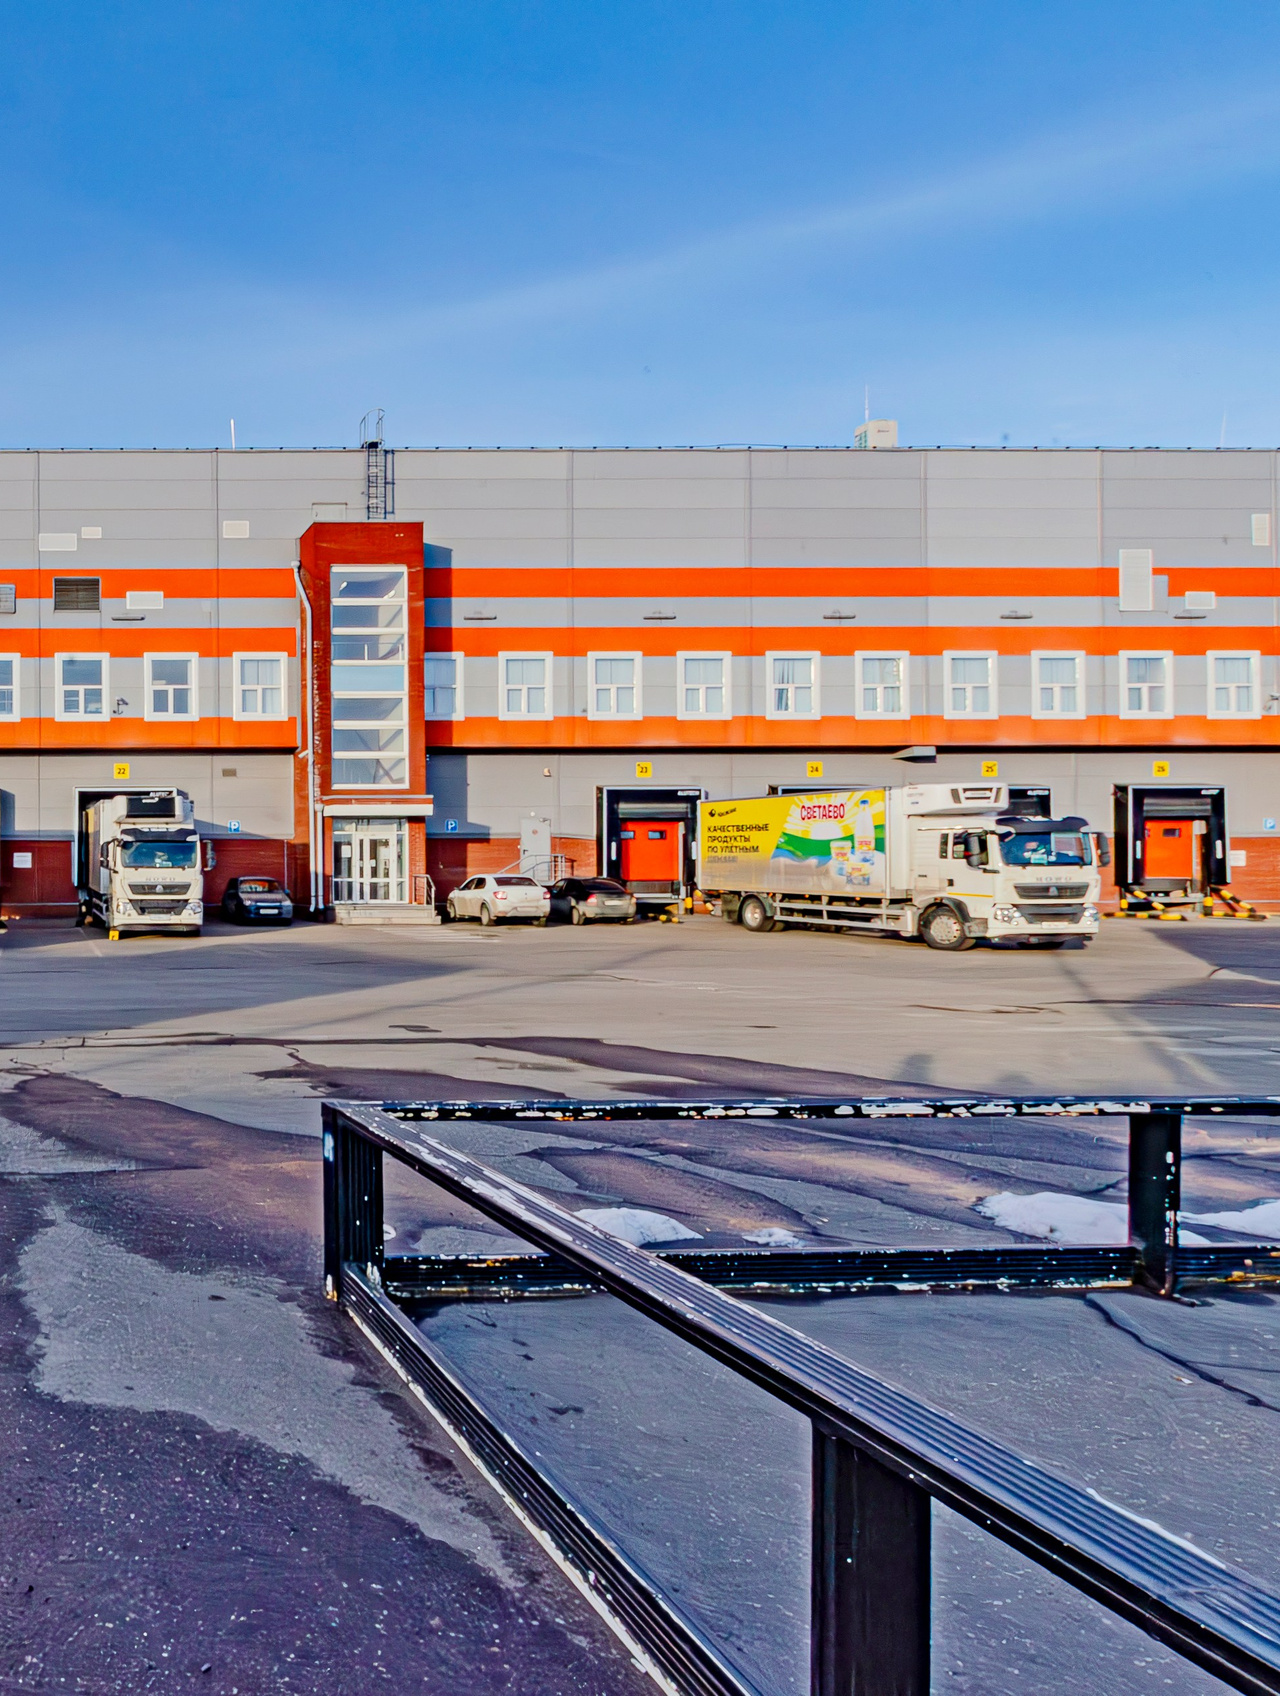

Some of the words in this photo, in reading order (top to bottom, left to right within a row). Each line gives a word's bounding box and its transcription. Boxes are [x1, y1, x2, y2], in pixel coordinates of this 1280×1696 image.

[639, 766, 648, 774] 23
[810, 765, 819, 773] 24
[800, 803, 846, 821] СВЕТАЕВО
[707, 823, 770, 833] КАЧЕСТВЕННЫЕ
[707, 834, 751, 844] ПРОДУКТЫ
